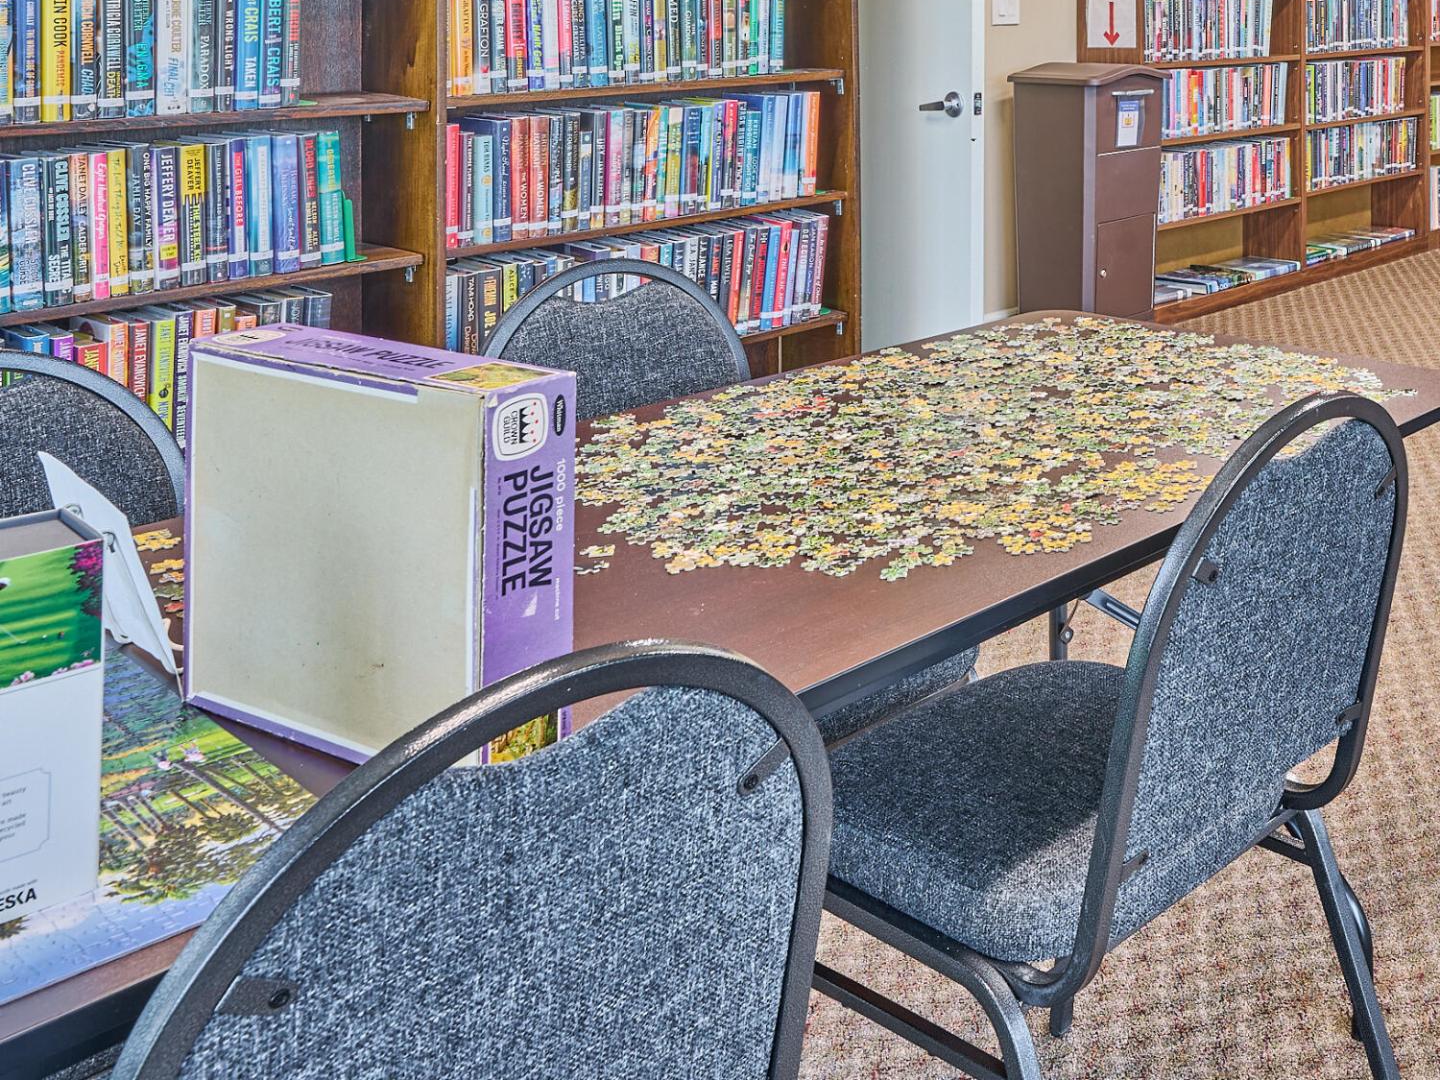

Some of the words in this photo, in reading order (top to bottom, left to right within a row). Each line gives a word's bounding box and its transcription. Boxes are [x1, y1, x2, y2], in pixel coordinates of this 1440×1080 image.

[53, 17, 67, 48] COOK
[171, 15, 181, 53] COULTER
[225, 10, 235, 42] WRONG
[245, 8, 259, 43] CRAIS
[480, 3, 490, 58] GRAFTON
[614, 25, 624, 54] Black
[81, 21, 94, 66] CORNWELL
[107, 26, 121, 74] CORNWELL
[224, 44, 234, 71] LIGHT
[136, 42, 148, 89] ENIGMA
[201, 35, 210, 89] PARADOX
[245, 56, 257, 88] TAKEN
[267, 47, 281, 87] CRAIS
[78, 157, 87, 183] JANET
[305, 139, 315, 169] BLOOD
[22, 164, 37, 195] CLIVE
[132, 174, 141, 204] JAMIE
[161, 154, 175, 199] JEFFERY
[194, 157, 202, 190] JEFFERY
[235, 168, 243, 188] GIRL
[78, 184, 87, 218] DAILEY
[132, 206, 141, 226] DAY
[235, 190, 244, 227] BEFORE
[520, 183, 529, 220] WOMEN
[536, 182, 545, 219] WOMEN
[24, 196, 38, 244] CUSSLER
[144, 218, 152, 251] FAMILY
[161, 200, 175, 242] DEAVER
[135, 328, 147, 353] JANET
[160, 324, 170, 349] JANET
[178, 315, 189, 338] JANET
[178, 339, 189, 373] EVANOVICH
[286, 337, 369, 358] JIGSAW
[369, 347, 456, 370] PUZZLE
[503, 416, 511, 444] GUILD
[510, 410, 518, 445] CROWN
[556, 458, 567, 492] 1000
[529, 464, 554, 587] JIGSAW
[554, 496, 565, 532] piece
[501, 469, 528, 597] PUZZLE
